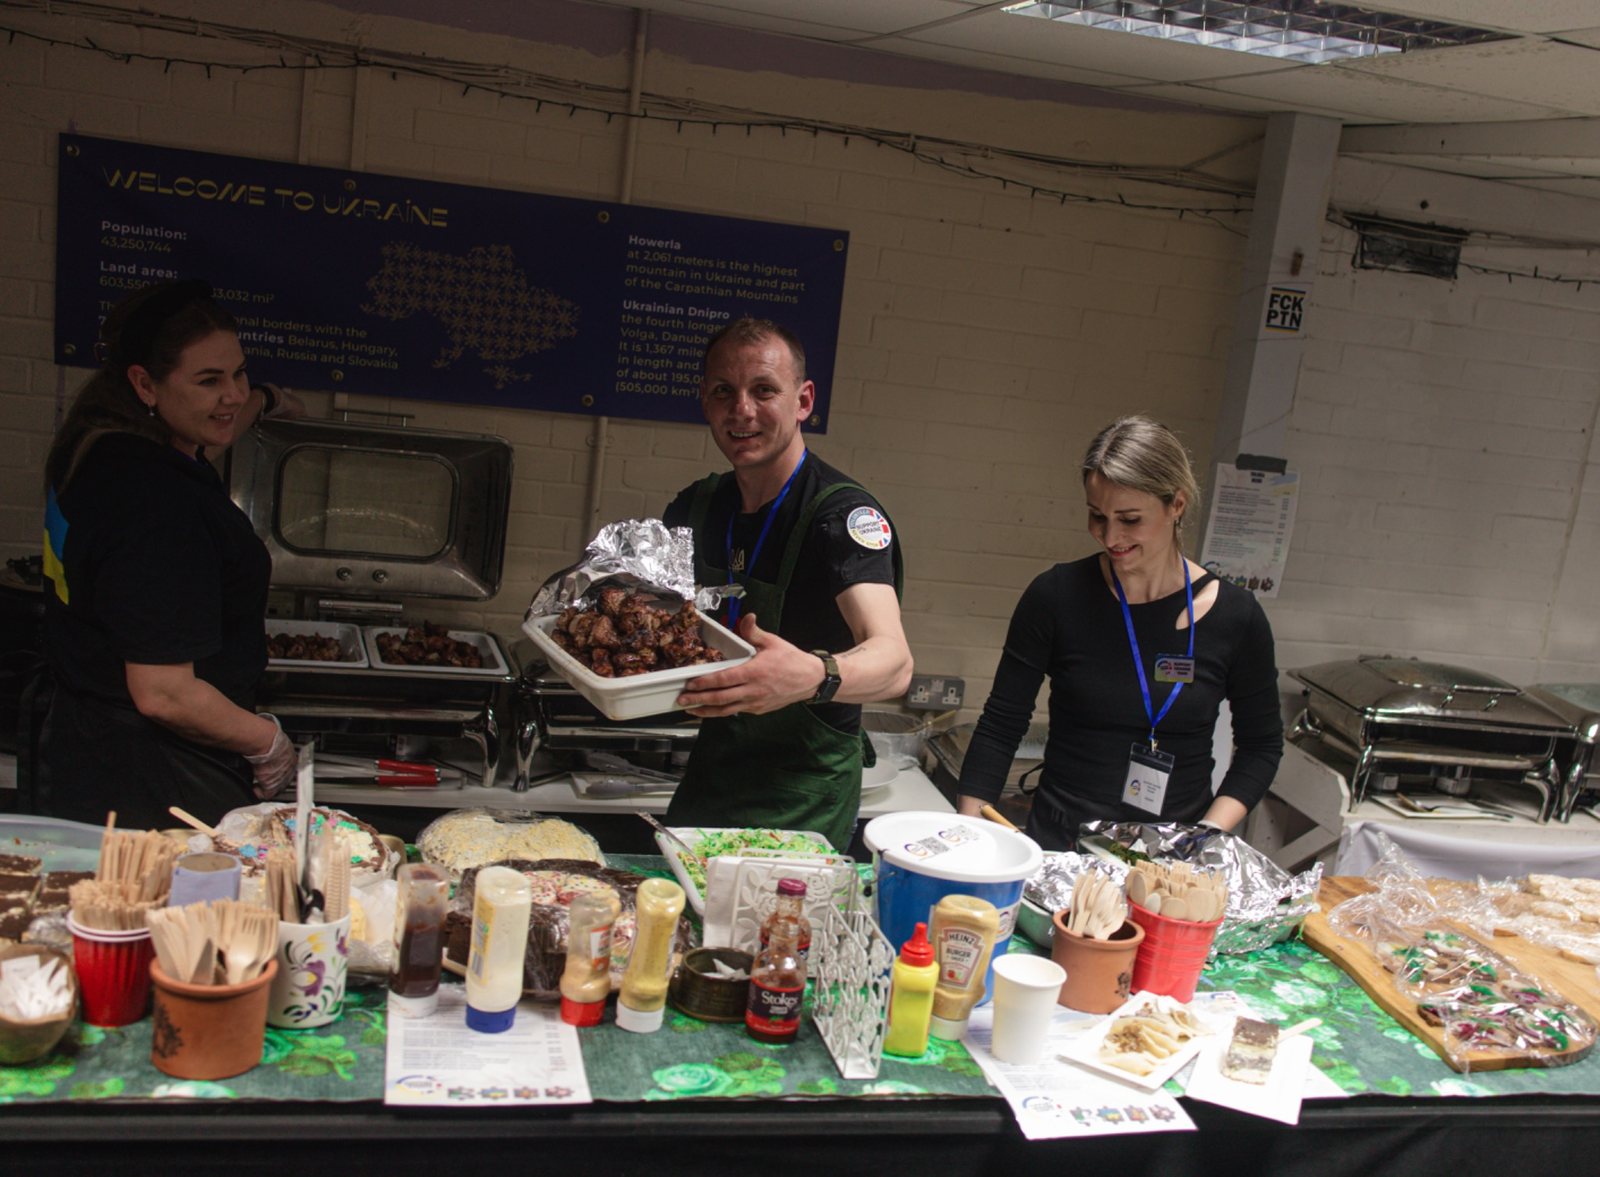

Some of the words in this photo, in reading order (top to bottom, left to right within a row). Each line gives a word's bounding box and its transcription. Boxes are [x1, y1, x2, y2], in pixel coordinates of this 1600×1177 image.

[102, 166, 266, 206] WELCOME
[273, 187, 315, 212] TO
[101, 220, 187, 240] Population:
[100, 260, 136, 275] Land
[140, 265, 179, 280] area:
[627, 250, 640, 259] at
[674, 255, 714, 267] meters
[716, 257, 726, 268] is
[729, 260, 750, 272] the
[753, 262, 798, 278] highest
[626, 264, 686, 279] mountain
[690, 269, 702, 280] in
[705, 271, 752, 286] Ukraine
[755, 277, 778, 289] and
[780, 280, 805, 293] part
[624, 276, 637, 287] of
[641, 278, 662, 290] the
[665, 280, 733, 297] Carpathian
[735, 288, 798, 304] Mountains
[623, 299, 684, 316] Ukrainian
[687, 306, 730, 321] Dnipro
[1269, 293, 1304, 312] FCK
[263, 317, 312, 333] borders
[314, 323, 343, 336] with
[345, 326, 368, 339] the
[621, 314, 642, 325] the
[646, 315, 684, 328] fourth
[1266, 309, 1302, 327] PTN
[620, 327, 658, 341] Volga,
[288, 335, 339, 351] Belarus,
[342, 342, 398, 358] Hungary,
[632, 343, 642, 352] is
[277, 348, 317, 363] Russia
[320, 353, 344, 365] and
[348, 354, 400, 370] Slovakia
[618, 354, 630, 365] in
[633, 355, 672, 369] length
[676, 360, 700, 371] and
[616, 367, 629, 378] of
[632, 369, 667, 381] about
[949, 933, 976, 945] HEINZ
